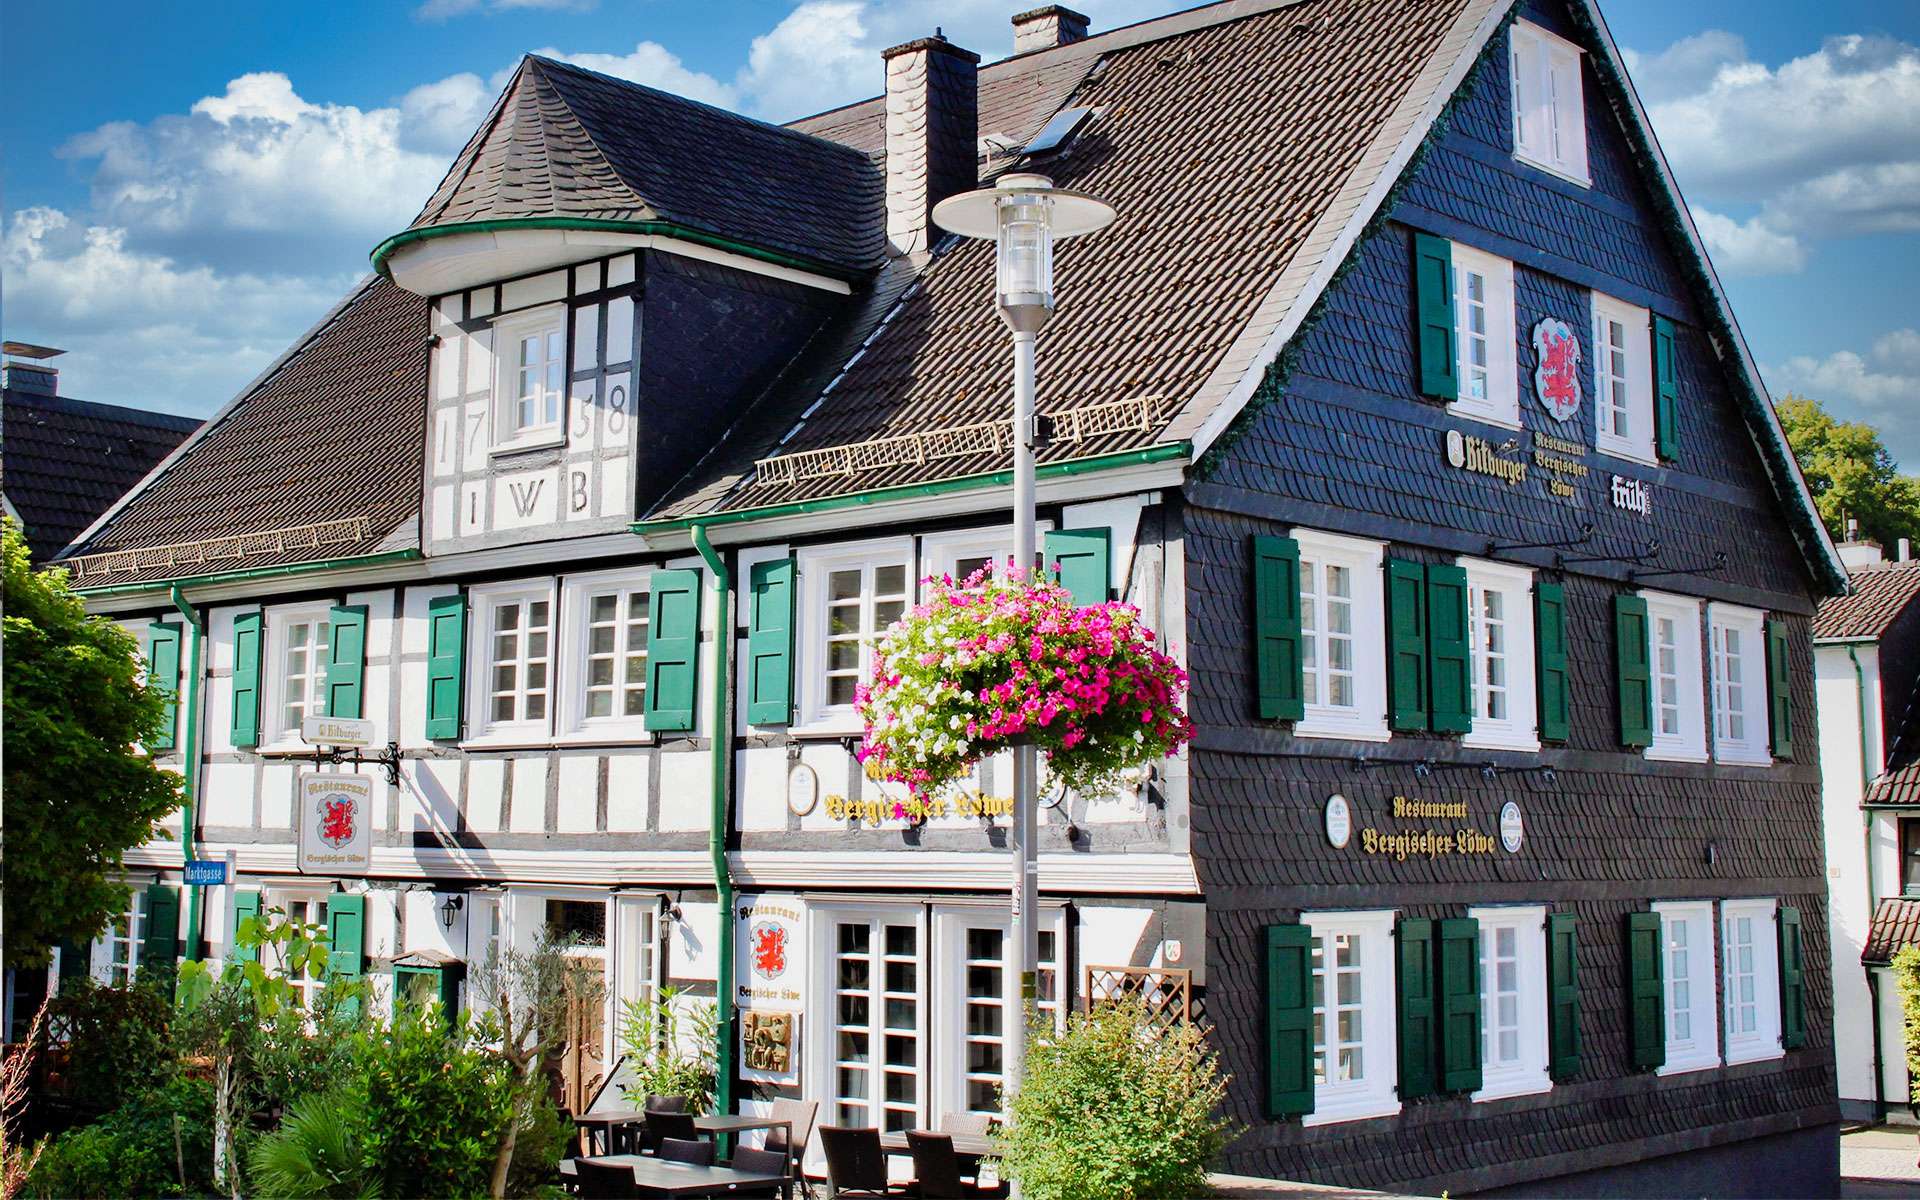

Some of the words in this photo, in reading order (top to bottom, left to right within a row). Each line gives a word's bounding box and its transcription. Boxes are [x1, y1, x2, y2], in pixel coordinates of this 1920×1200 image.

[1534, 431, 1585, 457] Restaurant
[1465, 434, 1527, 486] Bitburger
[1534, 450, 1588, 479] Bergischer
[1393, 796, 1468, 819] Restaurant
[1362, 827, 1451, 861] Bergischer
[1456, 828, 1496, 854] Löwe
[184, 866, 222, 883] Marktgasse
